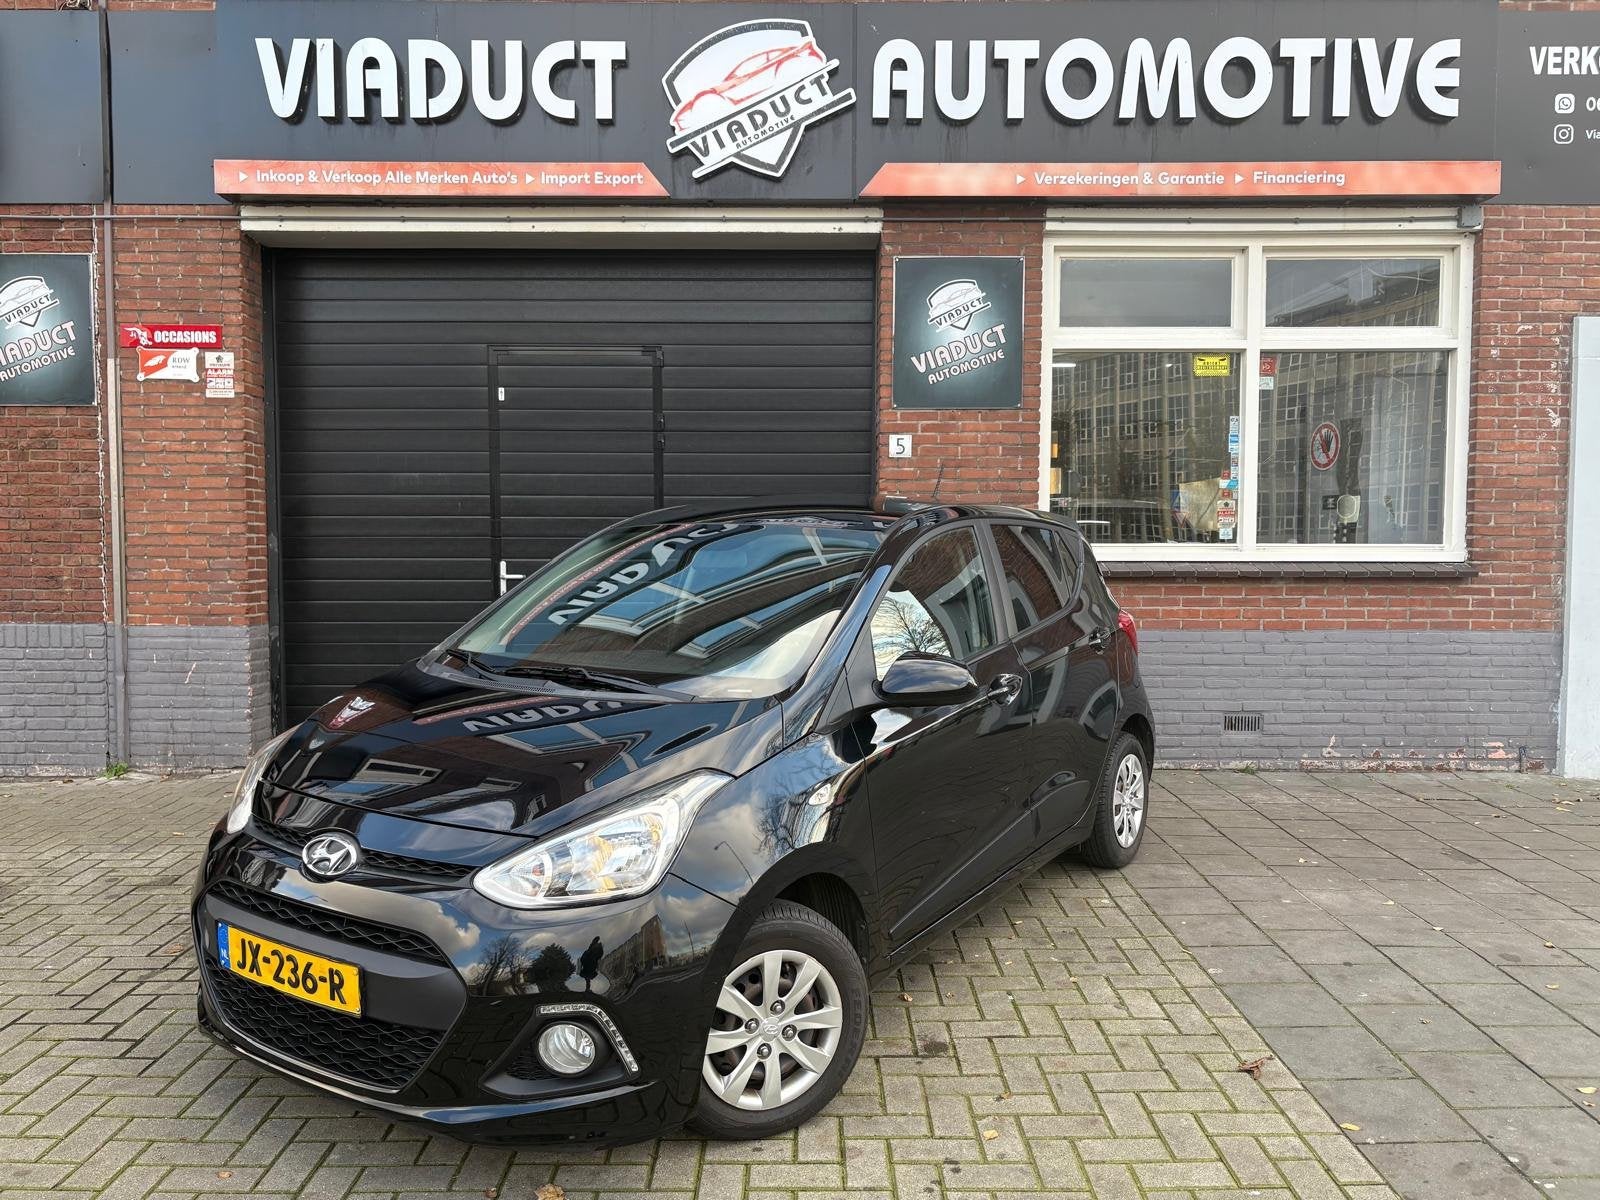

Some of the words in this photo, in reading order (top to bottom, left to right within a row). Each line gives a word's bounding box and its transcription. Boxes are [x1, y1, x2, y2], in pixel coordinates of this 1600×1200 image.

[1529, 46, 1600, 75] VERK
[254, 37, 627, 121] VIADUCT
[871, 36, 1461, 121] AUTOMOTIVE
[689, 74, 828, 158] VIADUCT
[735, 114, 796, 150] AUTOMOTIVE
[256, 169, 305, 185] Inkoop
[307, 170, 319, 182] &
[322, 170, 382, 186] Verkoop
[385, 171, 412, 184] Alle
[416, 172, 469, 184] Merken
[541, 171, 591, 187] Import
[594, 171, 644, 187] Export
[1034, 171, 1139, 188] Verzekeringen
[1142, 172, 1154, 185] &
[1158, 171, 1225, 185] Garantie
[1252, 170, 1346, 187] Financiering
[5, 295, 50, 323] VIADUCT
[935, 297, 983, 326] VIADUCT
[153, 330, 217, 344] OCCASIONS
[910, 323, 1007, 374] VIADUCT
[0, 345, 76, 382] AUTOMOTIVE
[928, 348, 1006, 385] AUTOMOTIVE
[895, 437, 906, 455] 5
[236, 938, 347, 1005] JX-236-R
